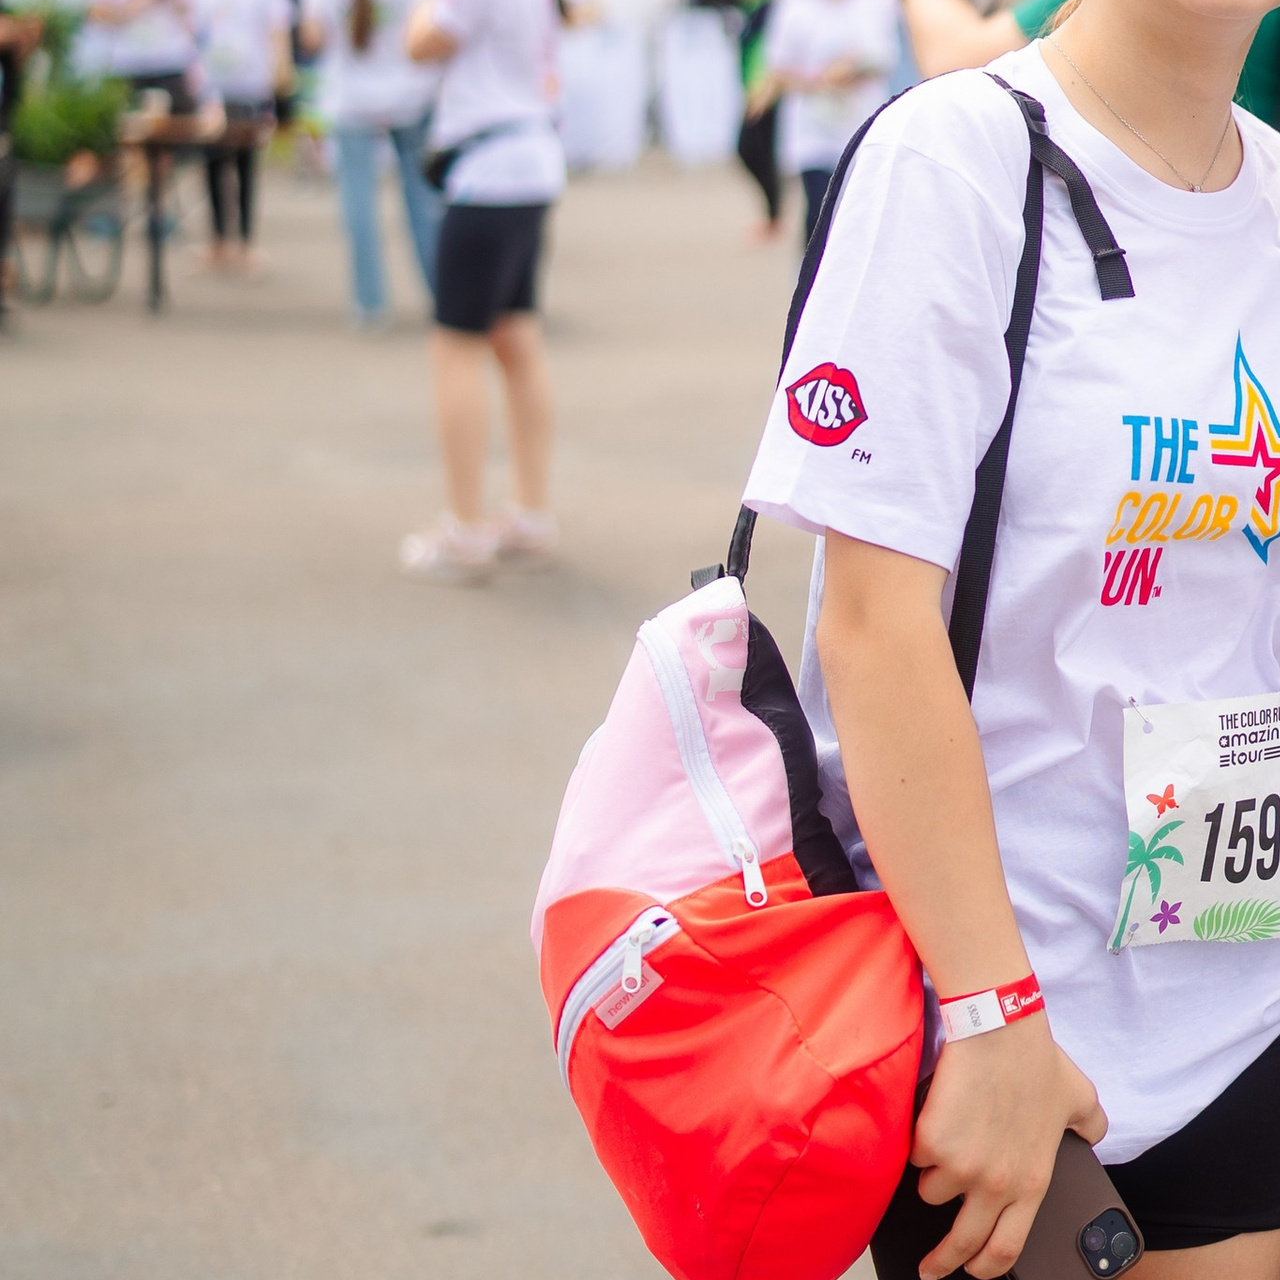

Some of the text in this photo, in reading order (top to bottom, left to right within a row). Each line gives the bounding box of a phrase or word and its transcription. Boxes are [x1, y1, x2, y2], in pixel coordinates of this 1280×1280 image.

[851, 448, 872, 464] FM
[1122, 414, 1199, 484] THE
[1105, 490, 1240, 546] COLOR
[1100, 547, 1163, 606] UN
[1219, 713, 1239, 731] THE
[1240, 708, 1272, 728] COLOR
[1231, 749, 1263, 766] tour
